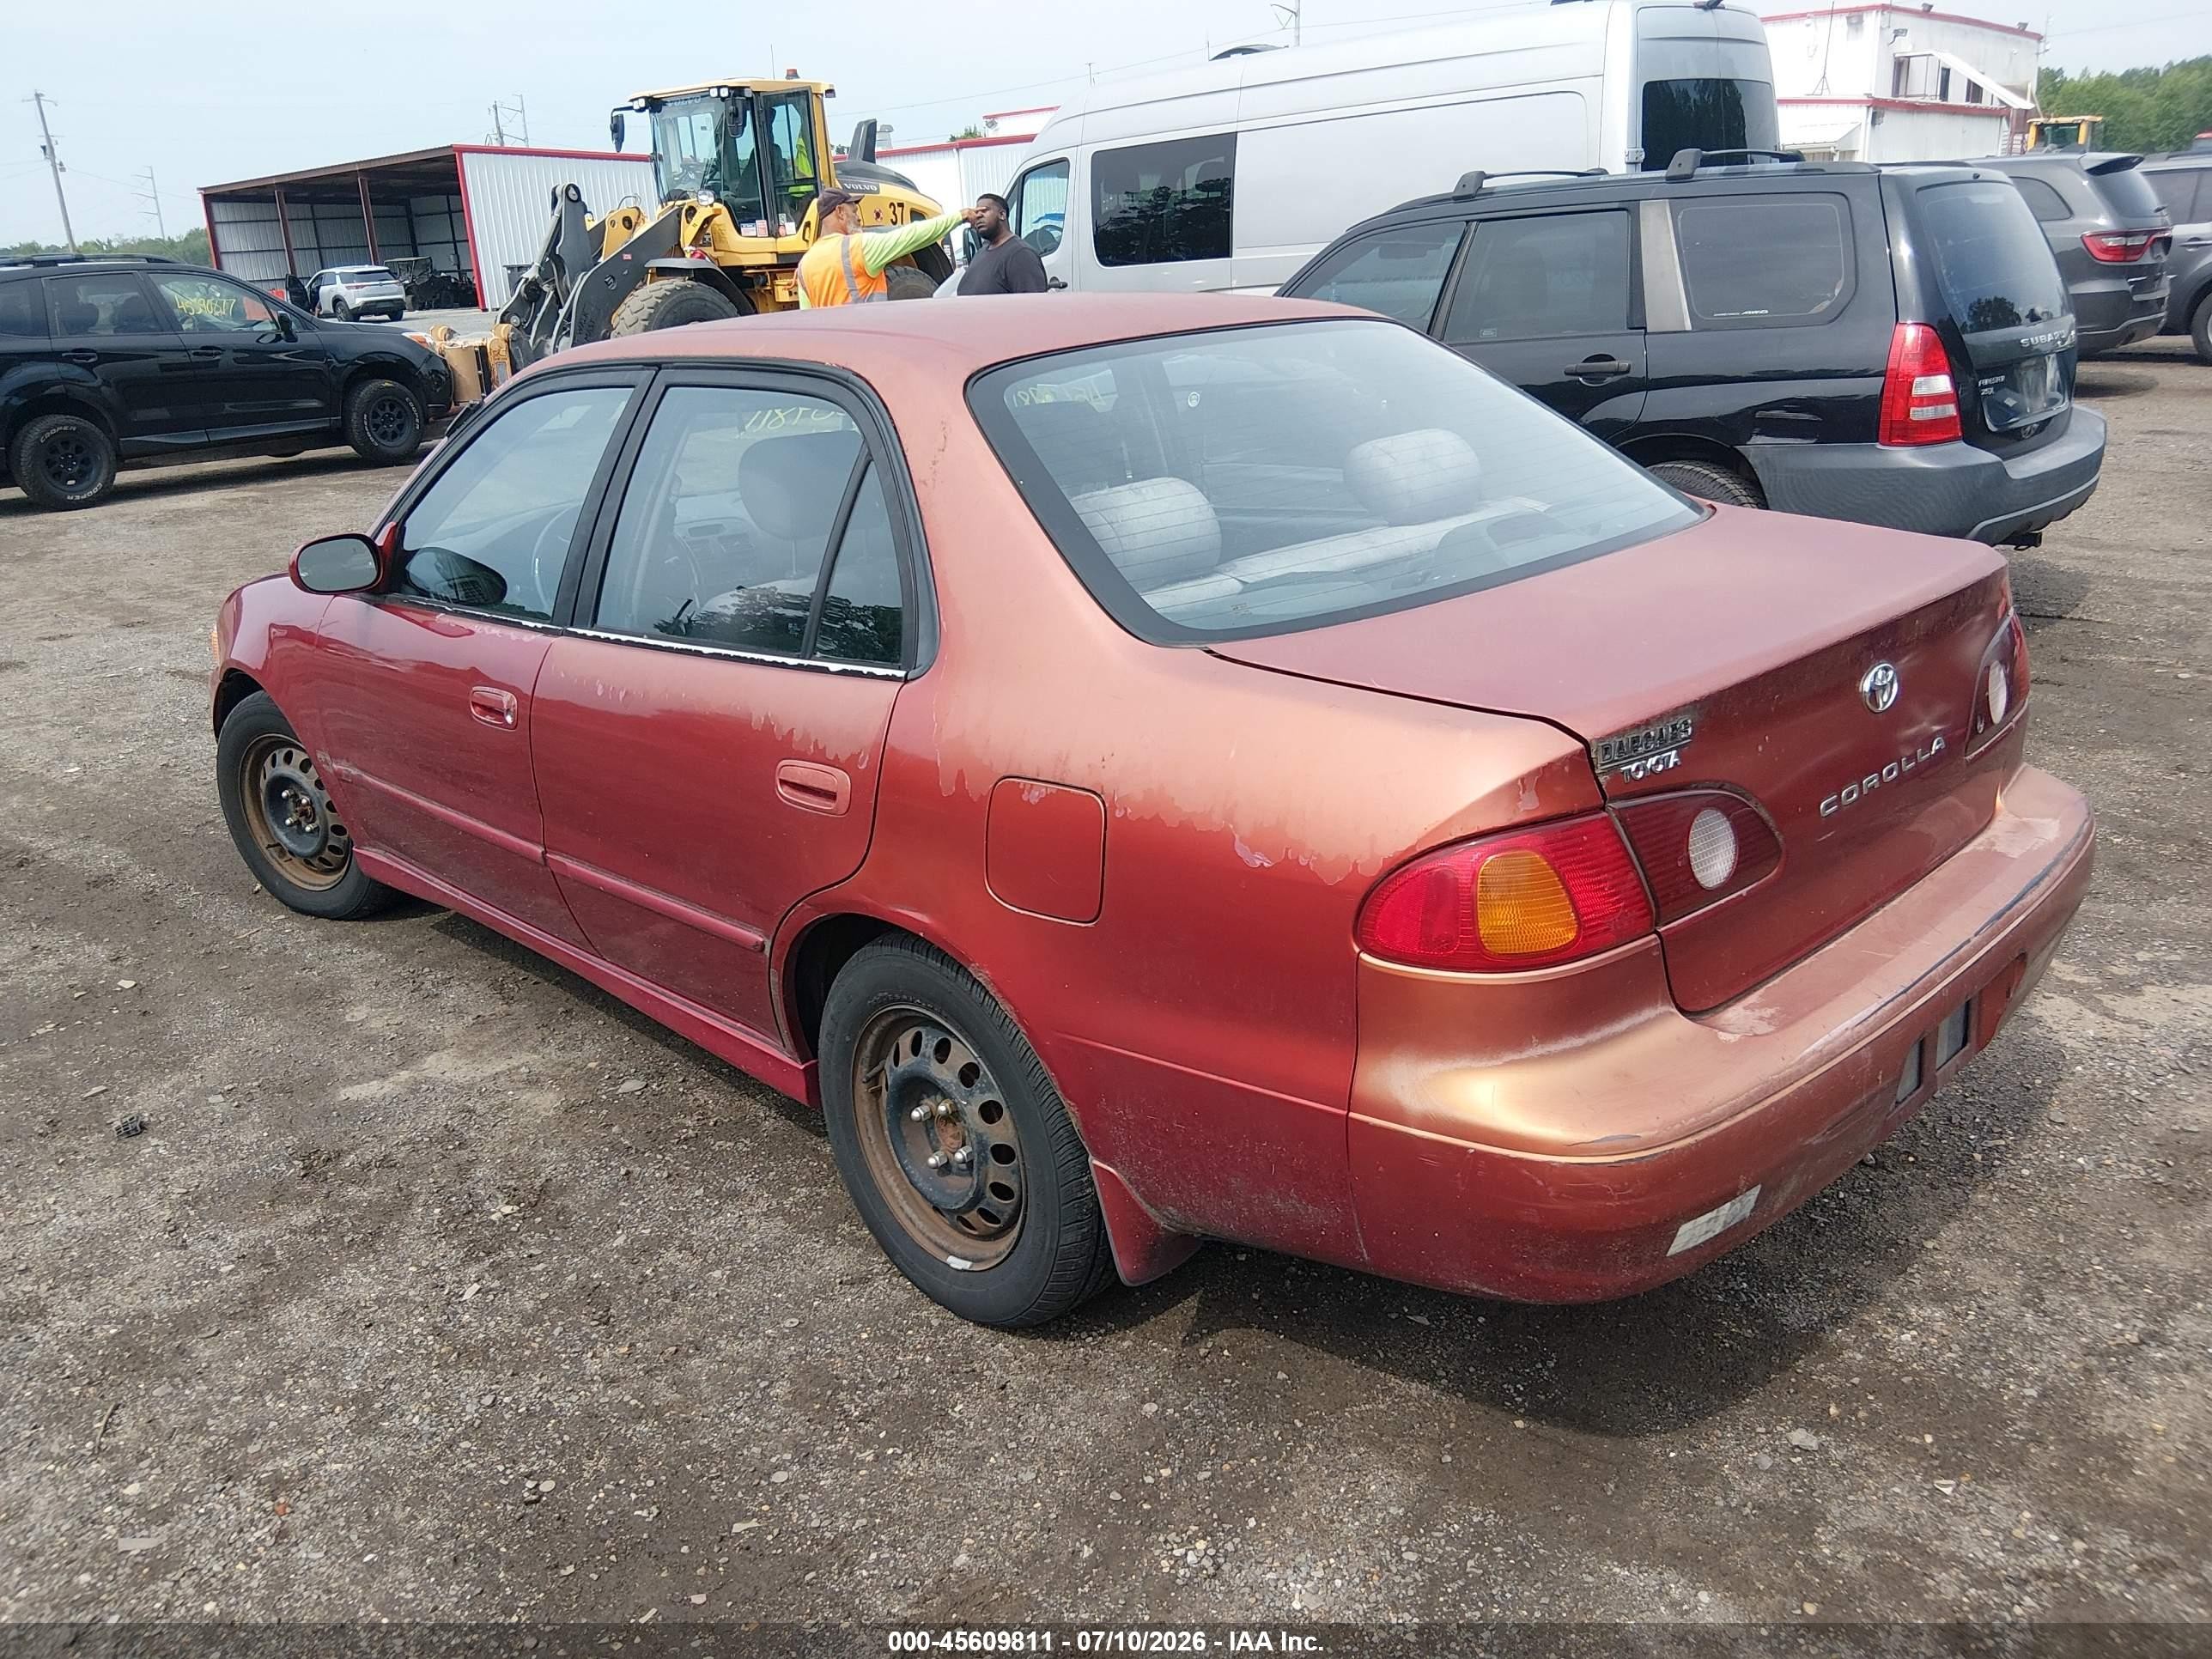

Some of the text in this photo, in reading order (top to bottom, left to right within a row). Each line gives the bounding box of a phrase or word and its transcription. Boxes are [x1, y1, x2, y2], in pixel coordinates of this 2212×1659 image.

[843, 182, 878, 191] VOLVO
[889, 202, 905, 226] 37
[2020, 329, 2068, 348] SUBARU
[405, 397, 421, 430] COOPER
[40, 425, 77, 443] COOPER
[66, 482, 103, 501] COOPER
[1620, 750, 1682, 784] TOYOTA
[1819, 736, 1947, 817] COROLLA
